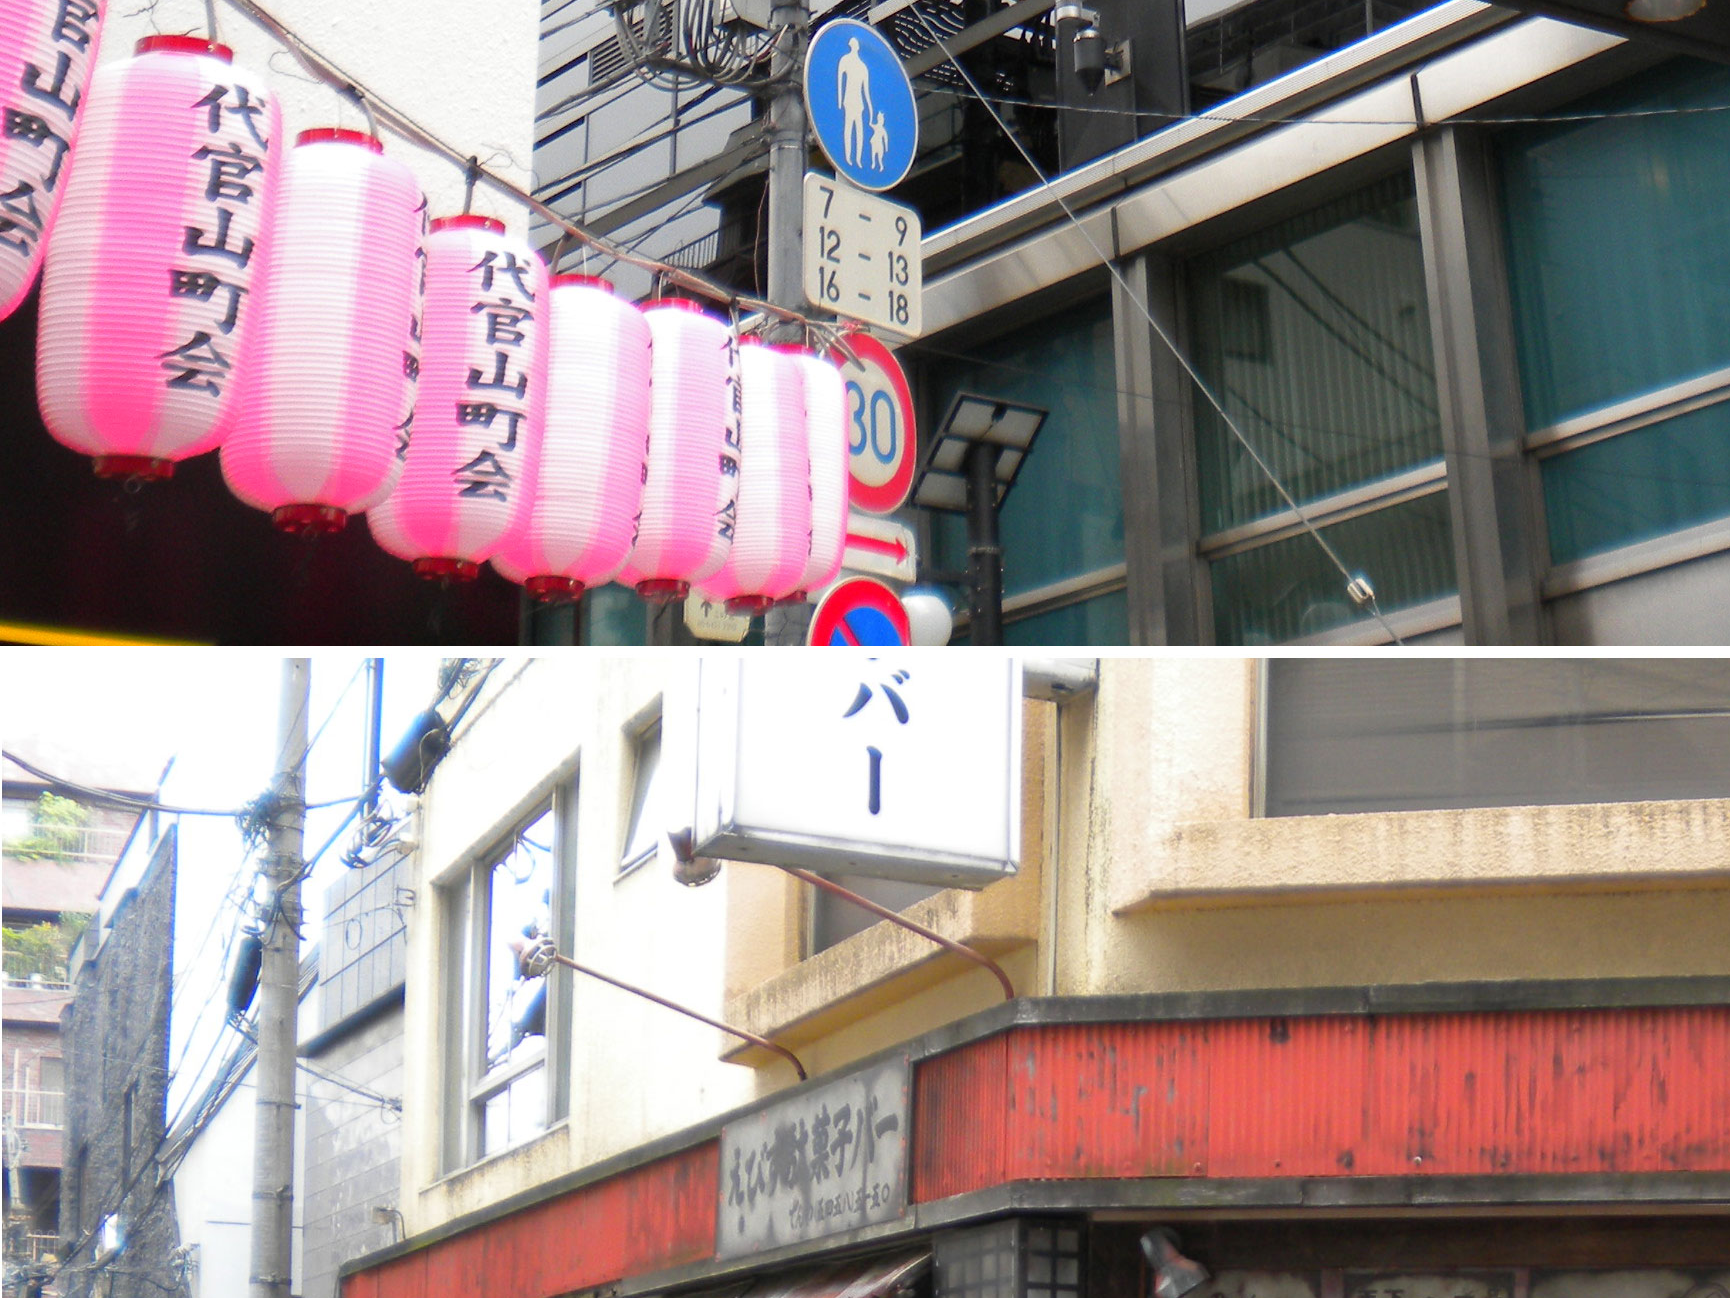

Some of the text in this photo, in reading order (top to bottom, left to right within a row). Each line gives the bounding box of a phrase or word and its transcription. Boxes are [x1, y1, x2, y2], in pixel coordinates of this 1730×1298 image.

[156, 84, 268, 398] 代官山町会
[820, 185, 834, 219] 7
[895, 216, 907, 247] 9
[819, 226, 841, 264] 12
[888, 251, 908, 286] 13
[819, 266, 840, 302] 16
[888, 290, 909, 325] 18
[451, 251, 536, 502] 代官山町会
[847, 380, 896, 465] 30
